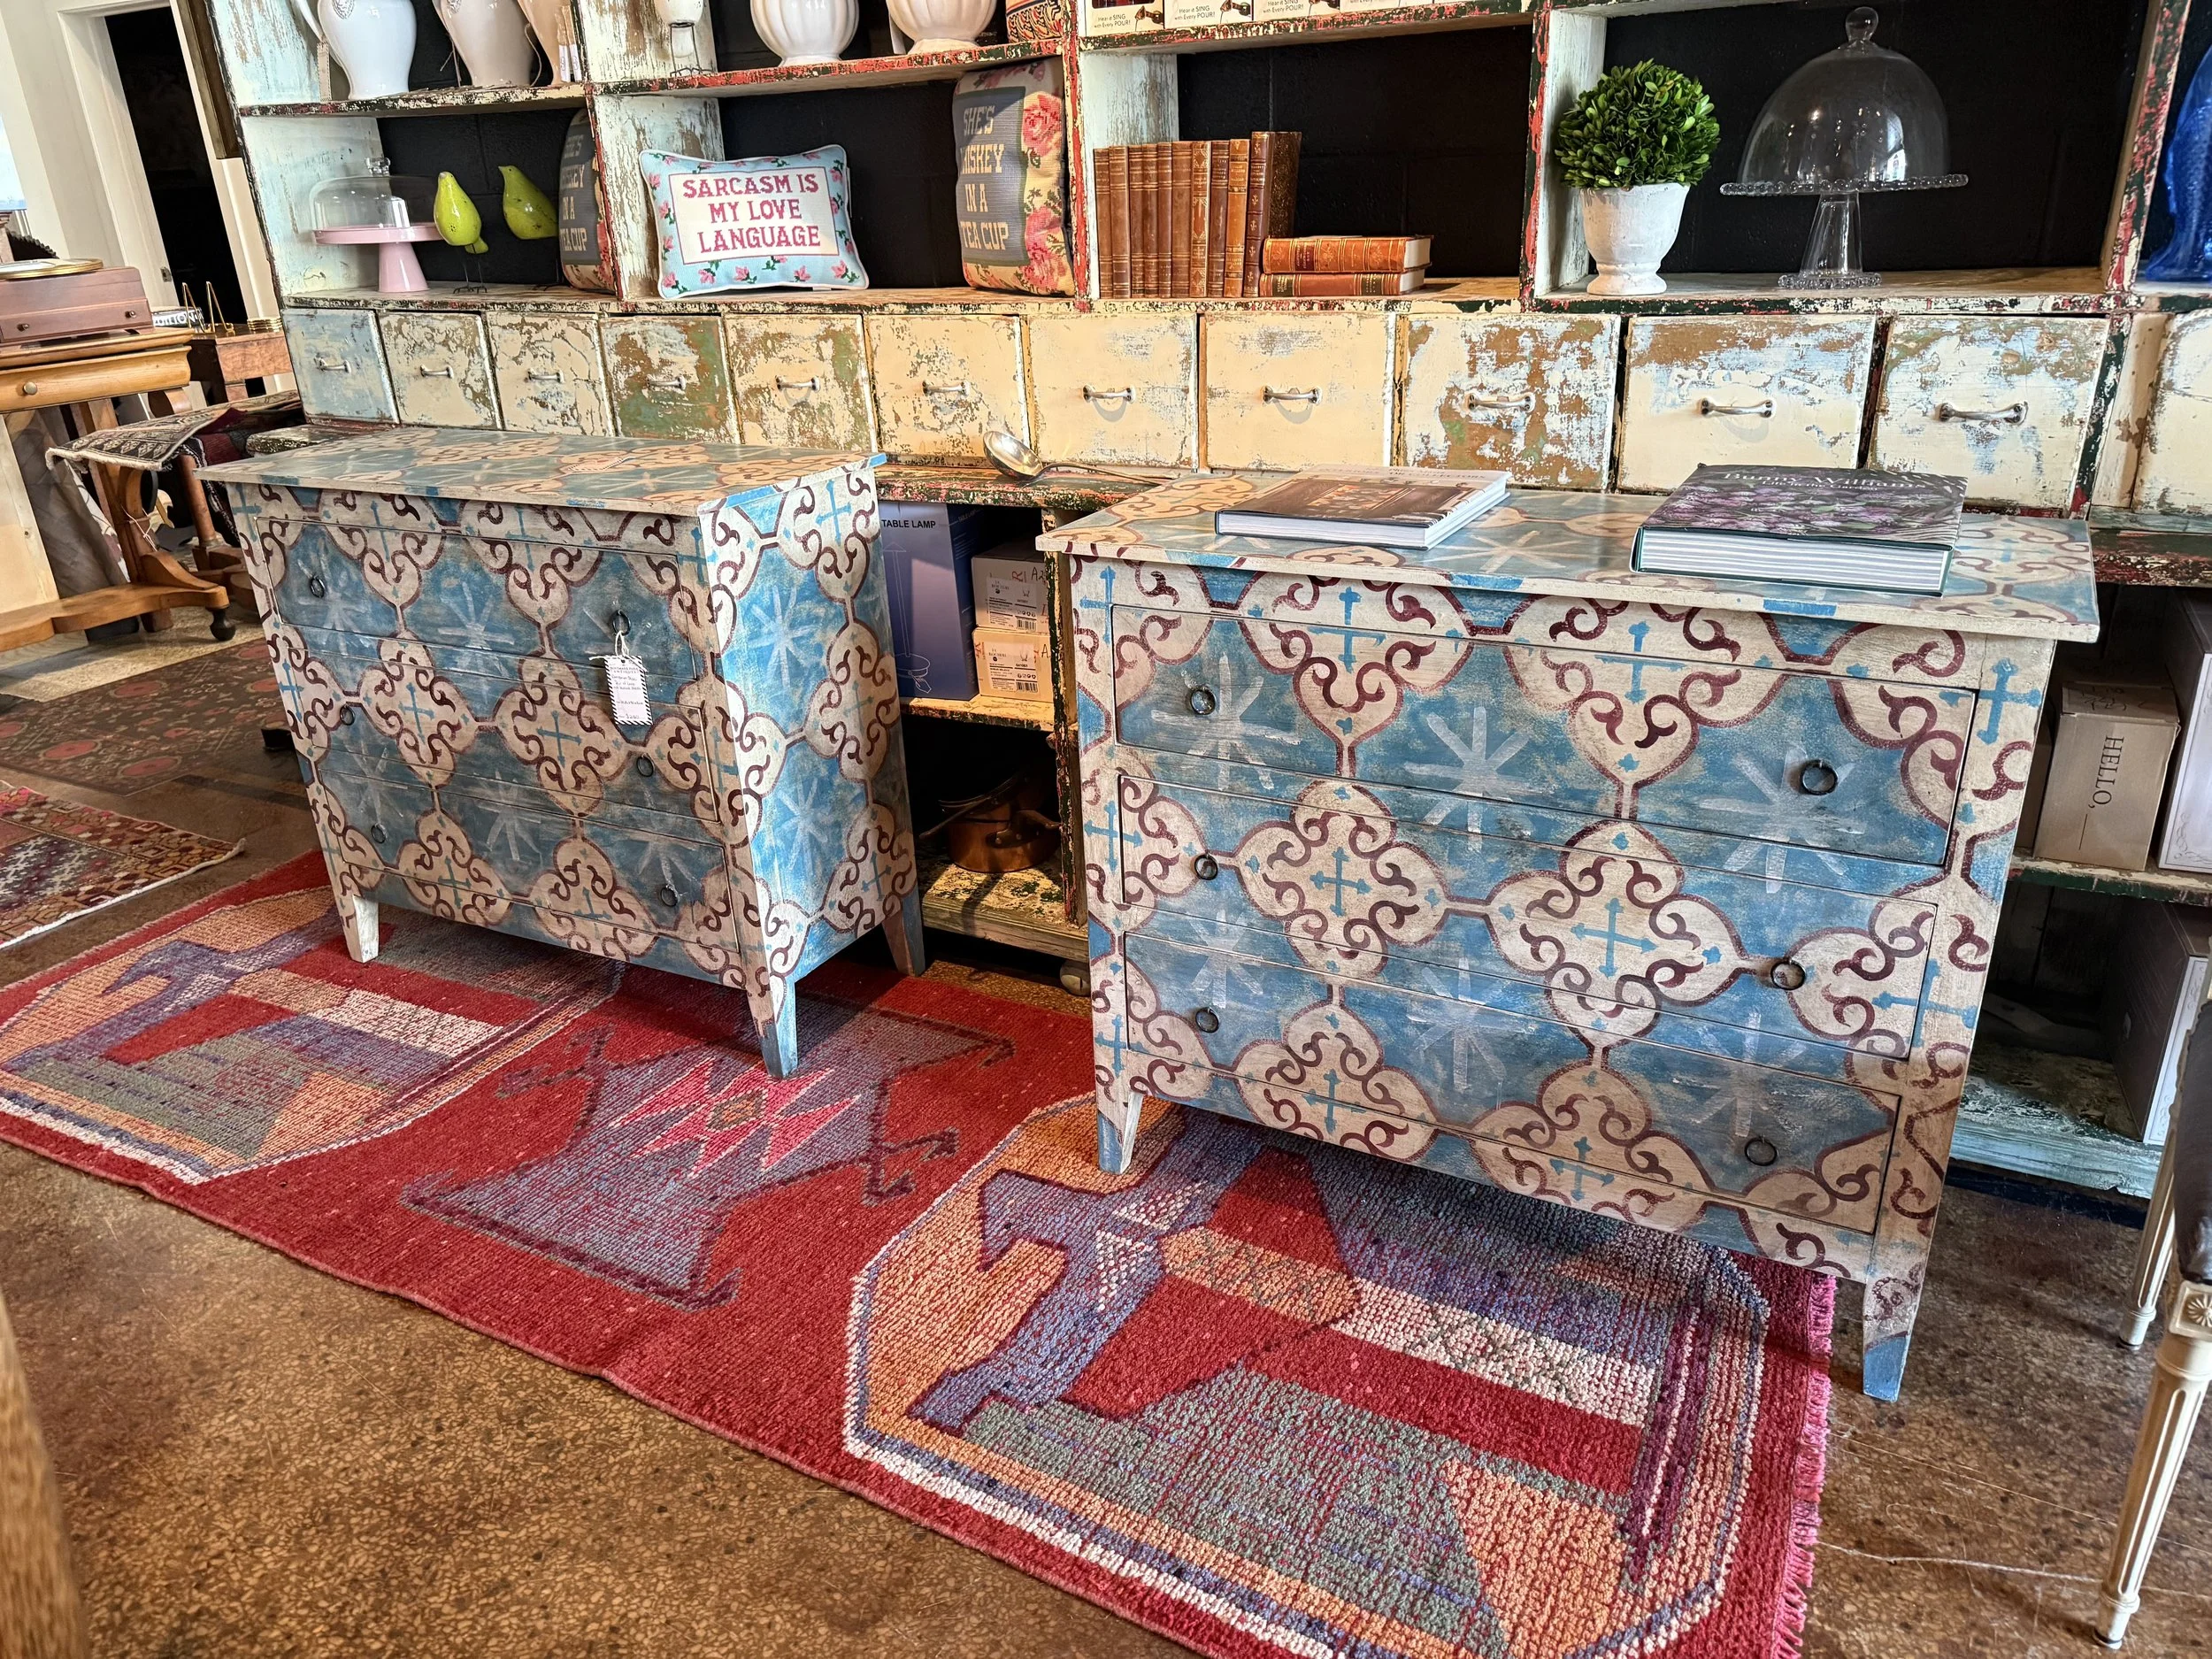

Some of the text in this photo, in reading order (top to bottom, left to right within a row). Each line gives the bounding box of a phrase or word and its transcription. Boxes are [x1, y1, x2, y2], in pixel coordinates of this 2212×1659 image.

[964, 104, 996, 136] SHE'S
[683, 173, 819, 199] SARCASM IS
[964, 183, 988, 213] IN A
[708, 198, 803, 224] MY LOVE
[697, 225, 821, 254] LANGUAGE
[960, 220, 1009, 250] TEA CUP
[1724, 472, 1926, 488] Bunny Williams
[881, 519, 936, 529] TABLE LAMP
[2087, 734, 2124, 809] HELLO,
